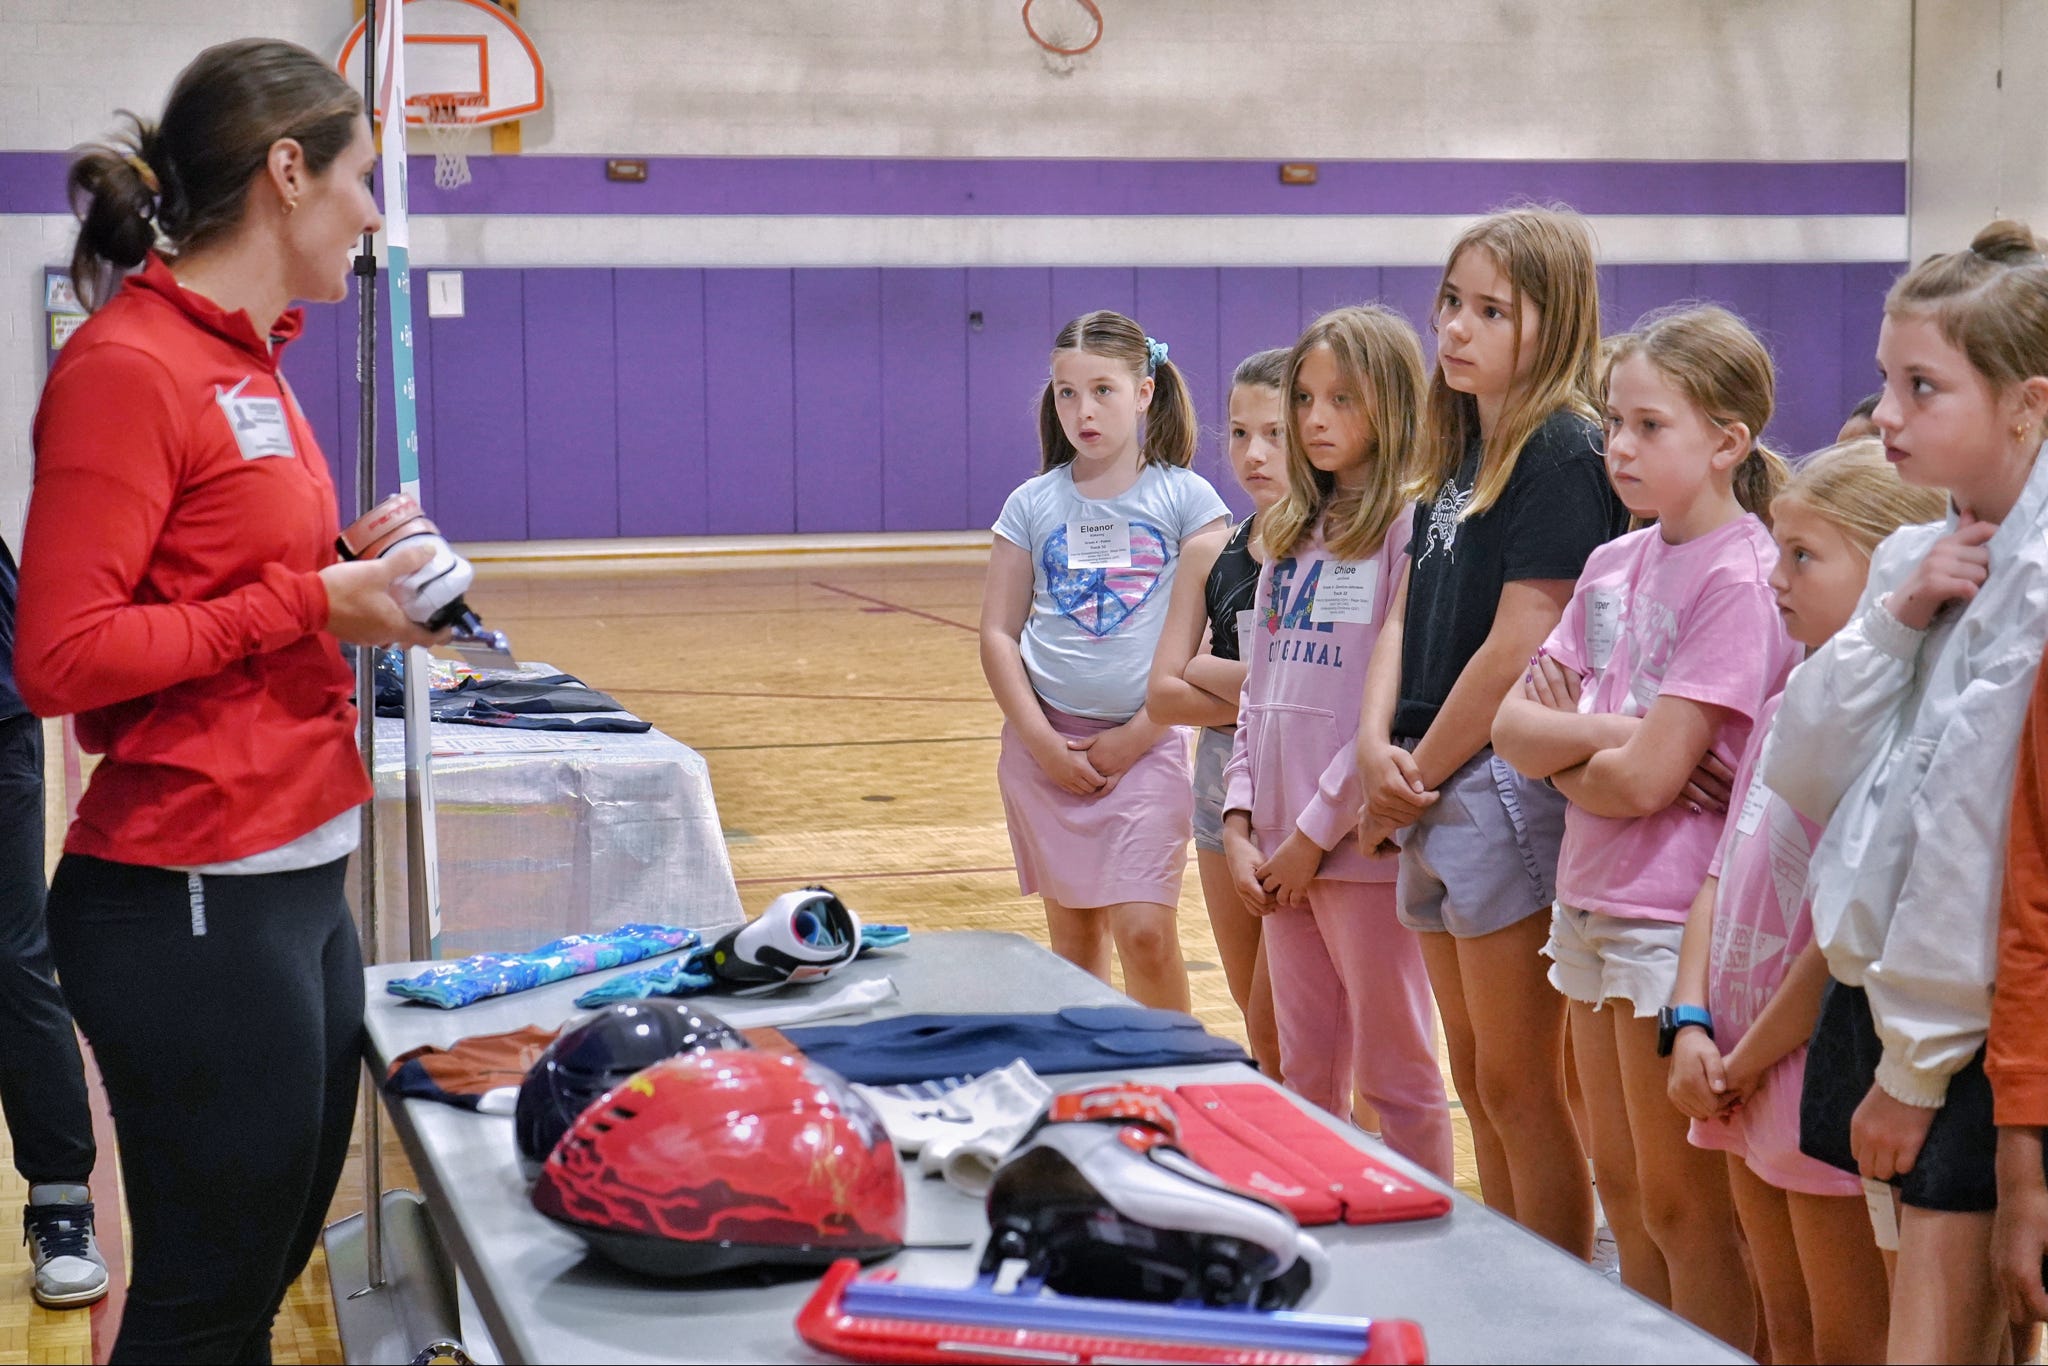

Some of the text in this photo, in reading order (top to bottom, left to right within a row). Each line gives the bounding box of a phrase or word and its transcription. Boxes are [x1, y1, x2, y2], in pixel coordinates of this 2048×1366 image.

[1080, 524, 1114, 533] Eleanor
[1334, 566, 1356, 575] Chloe
[1270, 557, 1334, 633] GA
